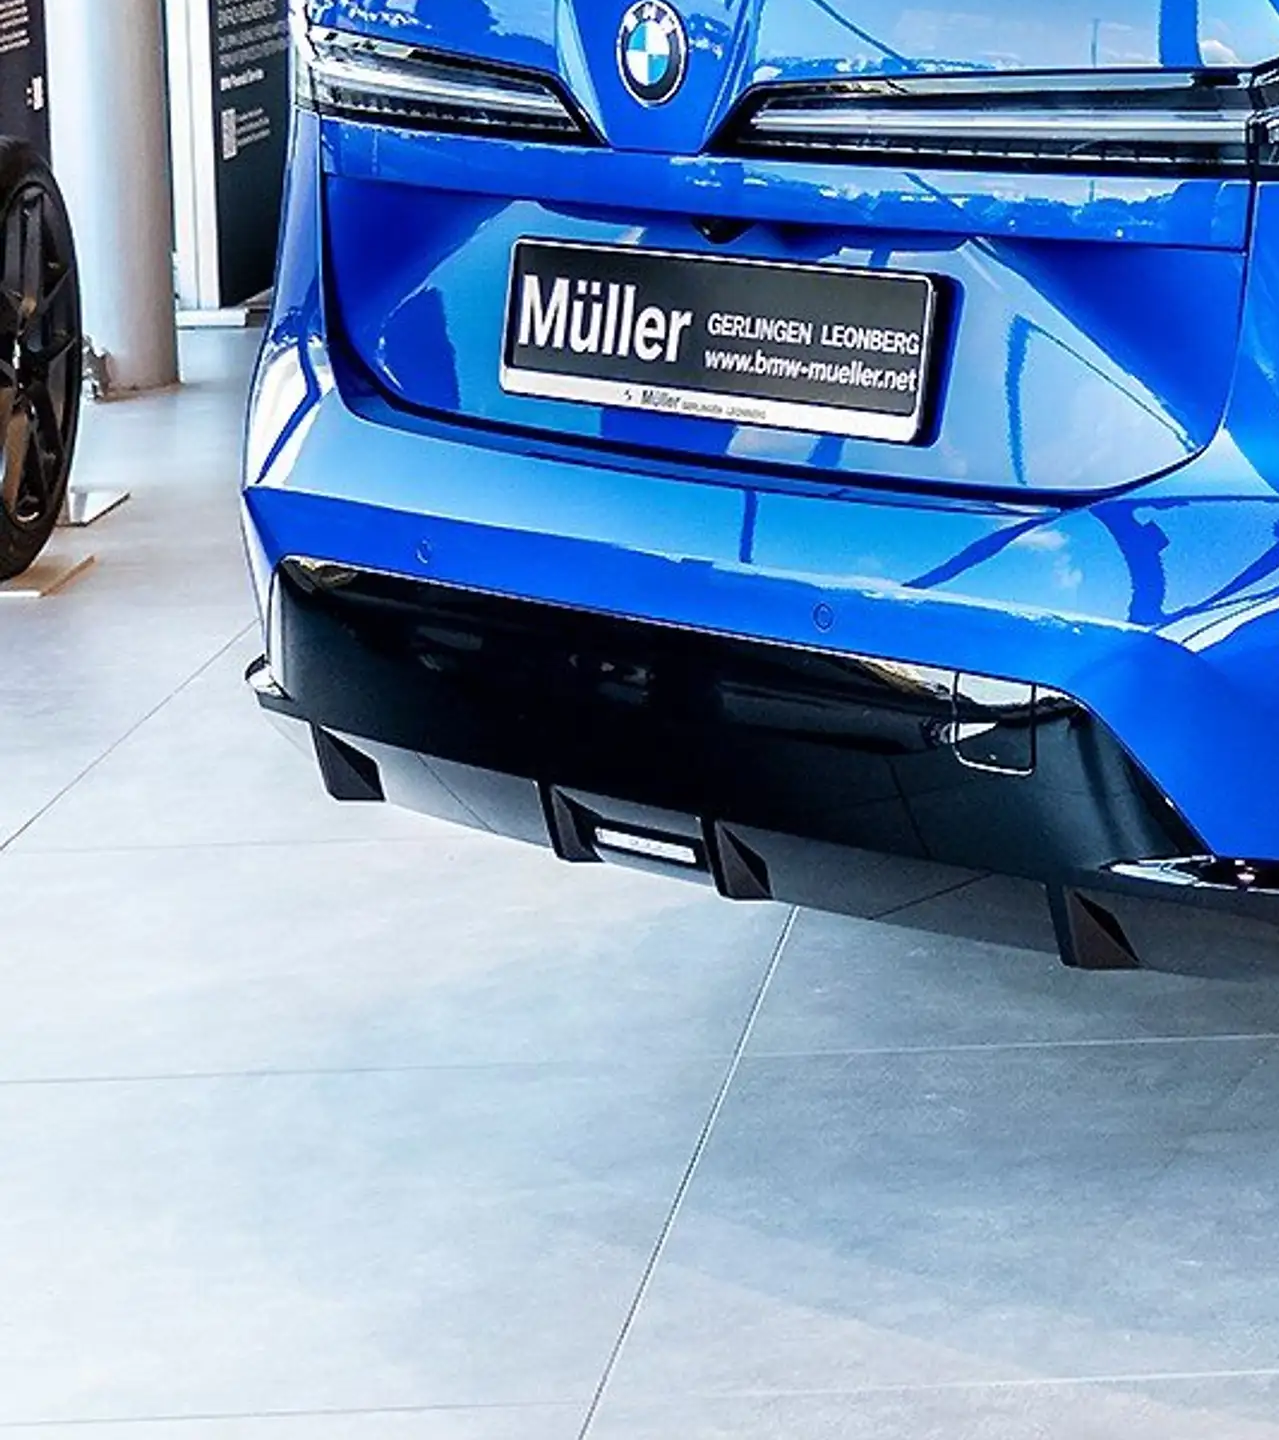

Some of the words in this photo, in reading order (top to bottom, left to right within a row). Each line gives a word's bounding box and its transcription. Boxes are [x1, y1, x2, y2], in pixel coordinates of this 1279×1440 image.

[517, 273, 692, 363] Müller
[706, 311, 813, 345] GERLINGEN
[820, 322, 921, 355] LEONBERG
[703, 348, 918, 393] www.bmw-mueller.net
